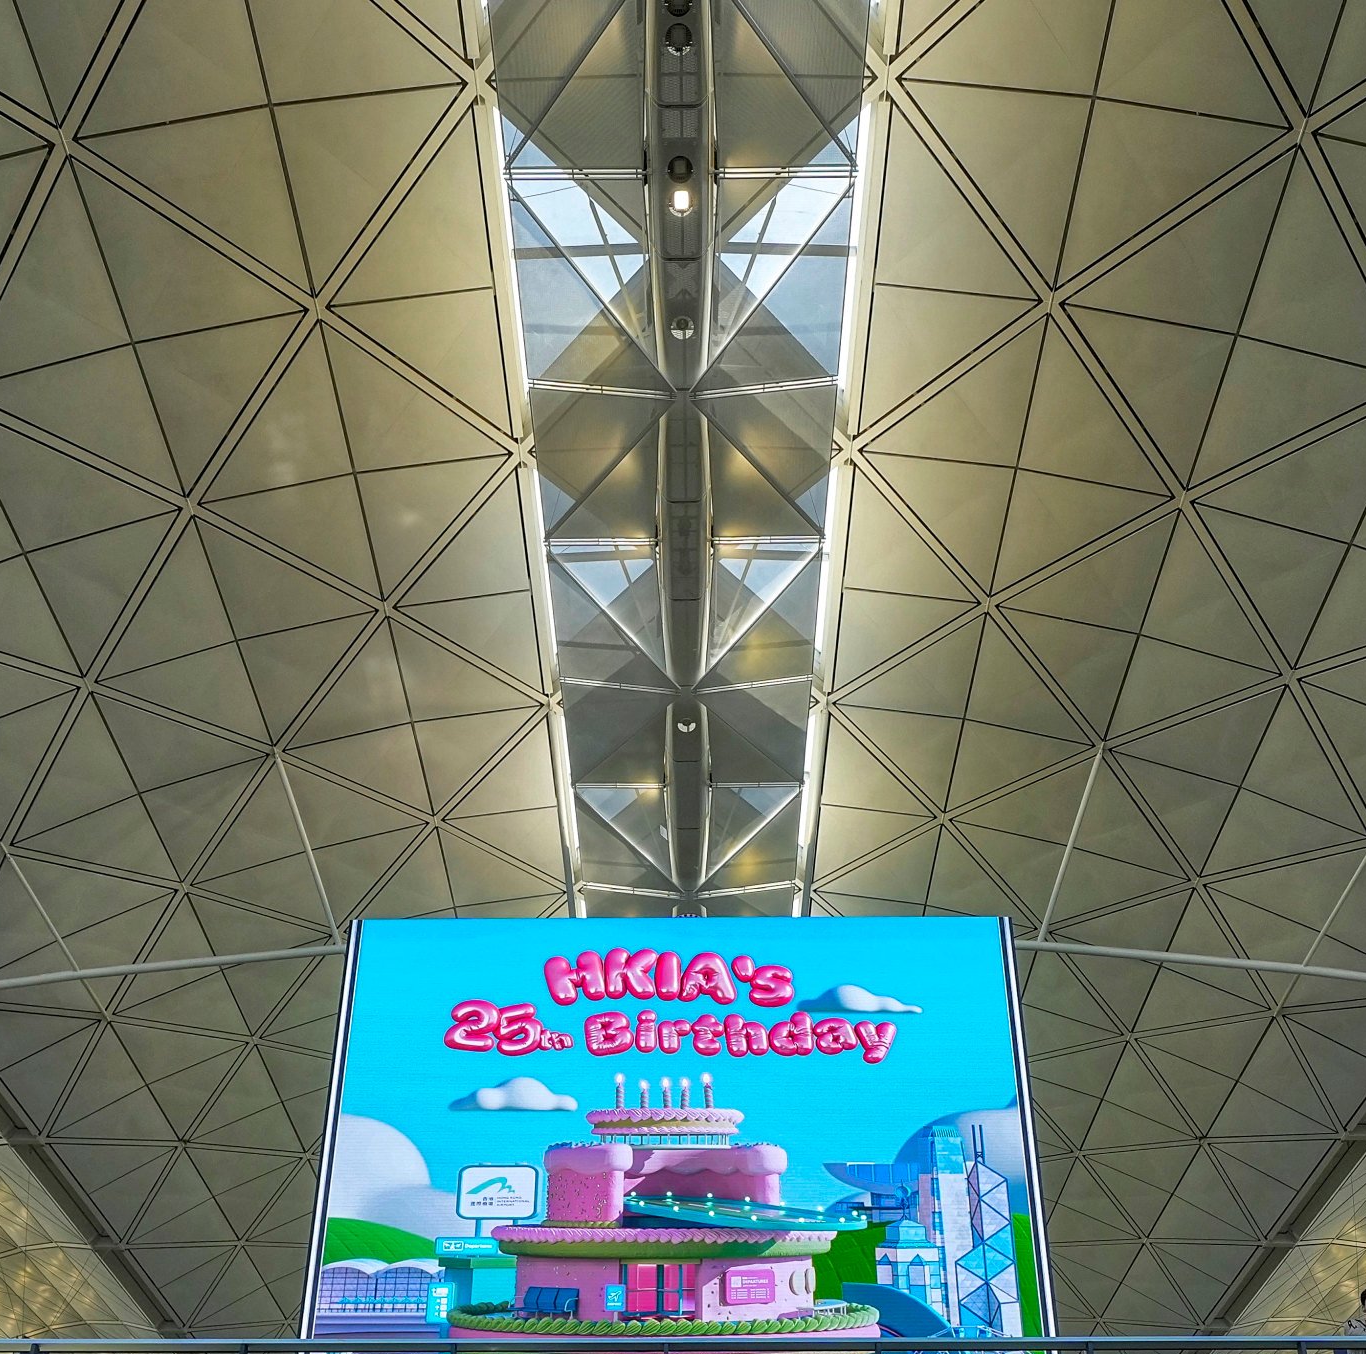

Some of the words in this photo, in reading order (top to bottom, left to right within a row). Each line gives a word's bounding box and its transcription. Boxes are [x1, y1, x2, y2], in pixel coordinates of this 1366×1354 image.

[543, 947, 795, 1008] HKIA's
[443, 999, 574, 1056] 25th
[584, 1009, 897, 1064] Birthday
